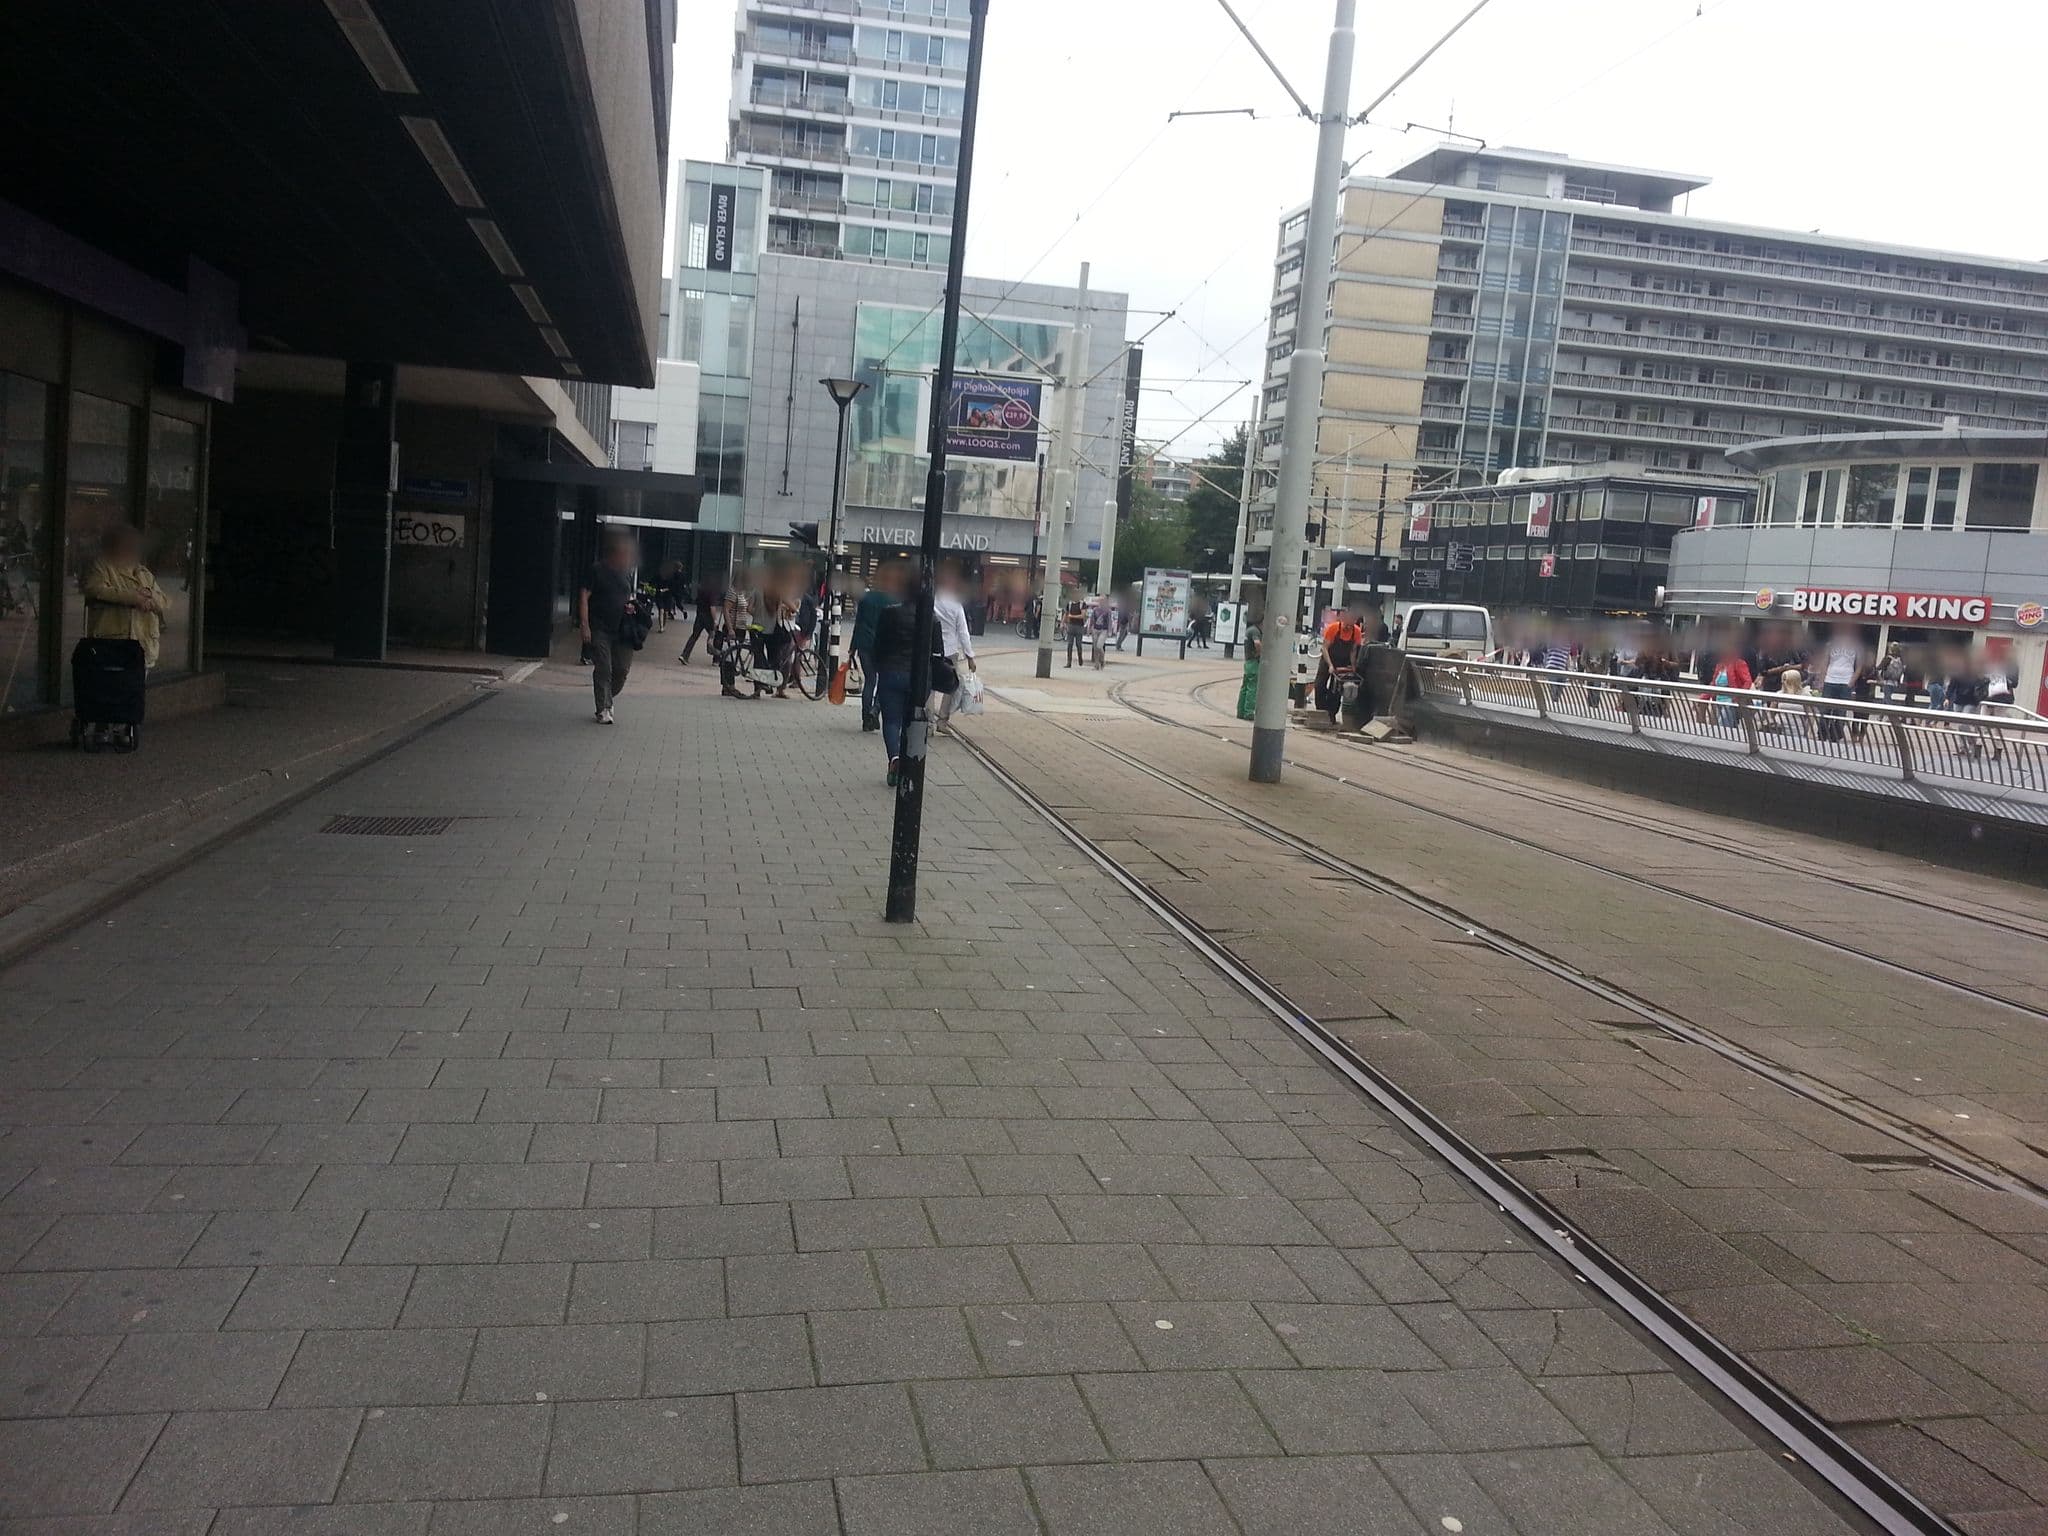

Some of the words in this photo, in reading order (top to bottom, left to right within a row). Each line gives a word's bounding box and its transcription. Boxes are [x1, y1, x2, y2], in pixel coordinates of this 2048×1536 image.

[718, 195, 728, 223] RIVER
[715, 225, 725, 261] ISLAND
[1123, 400, 1135, 431] RIVER
[864, 526, 916, 546] RIVER
[940, 532, 989, 551] LAND
[1530, 526, 1549, 537] PERRY
[1792, 590, 1898, 617] BURGER
[1906, 596, 1985, 622] KING
[2019, 612, 2042, 621] KING
